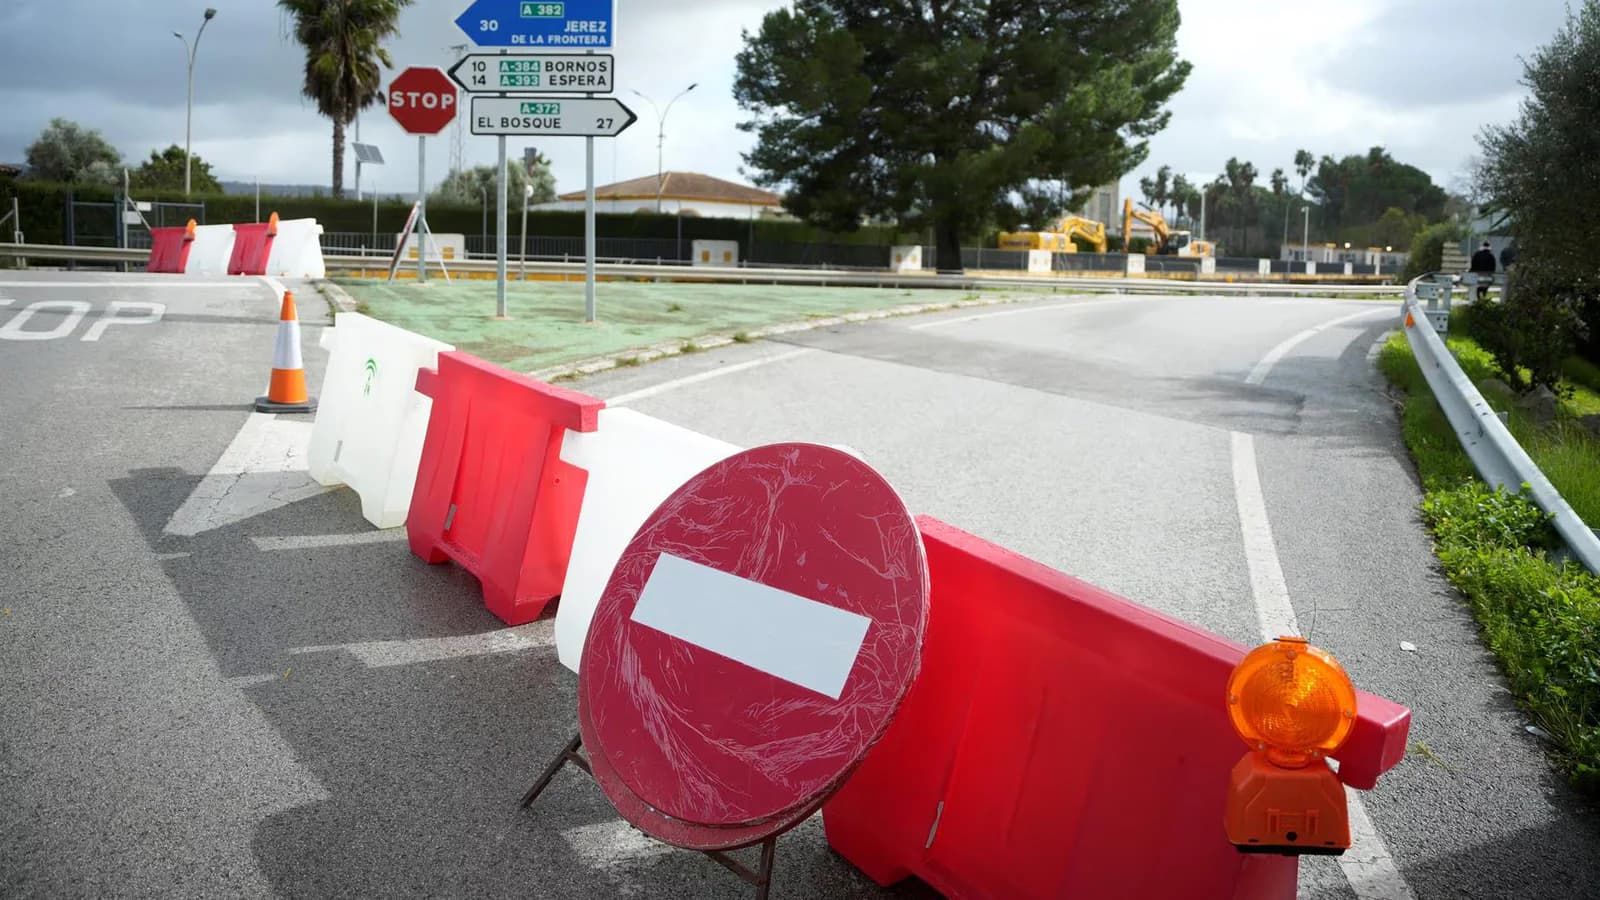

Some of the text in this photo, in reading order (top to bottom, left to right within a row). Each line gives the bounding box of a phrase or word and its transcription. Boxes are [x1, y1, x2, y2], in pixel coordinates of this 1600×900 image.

[523, 5, 562, 15] A 382
[480, 20, 607, 33] 30 JEREZ
[512, 35, 607, 44] DE LA FRONTERA
[472, 61, 607, 72] 10 A-384 BORNOS
[472, 75, 607, 86] 14 A-393 ESPERA
[391, 92, 454, 109] STOP
[521, 103, 560, 114] A-372
[478, 117, 613, 129] EL BOSQUE 27
[0, 299, 166, 341] OP
